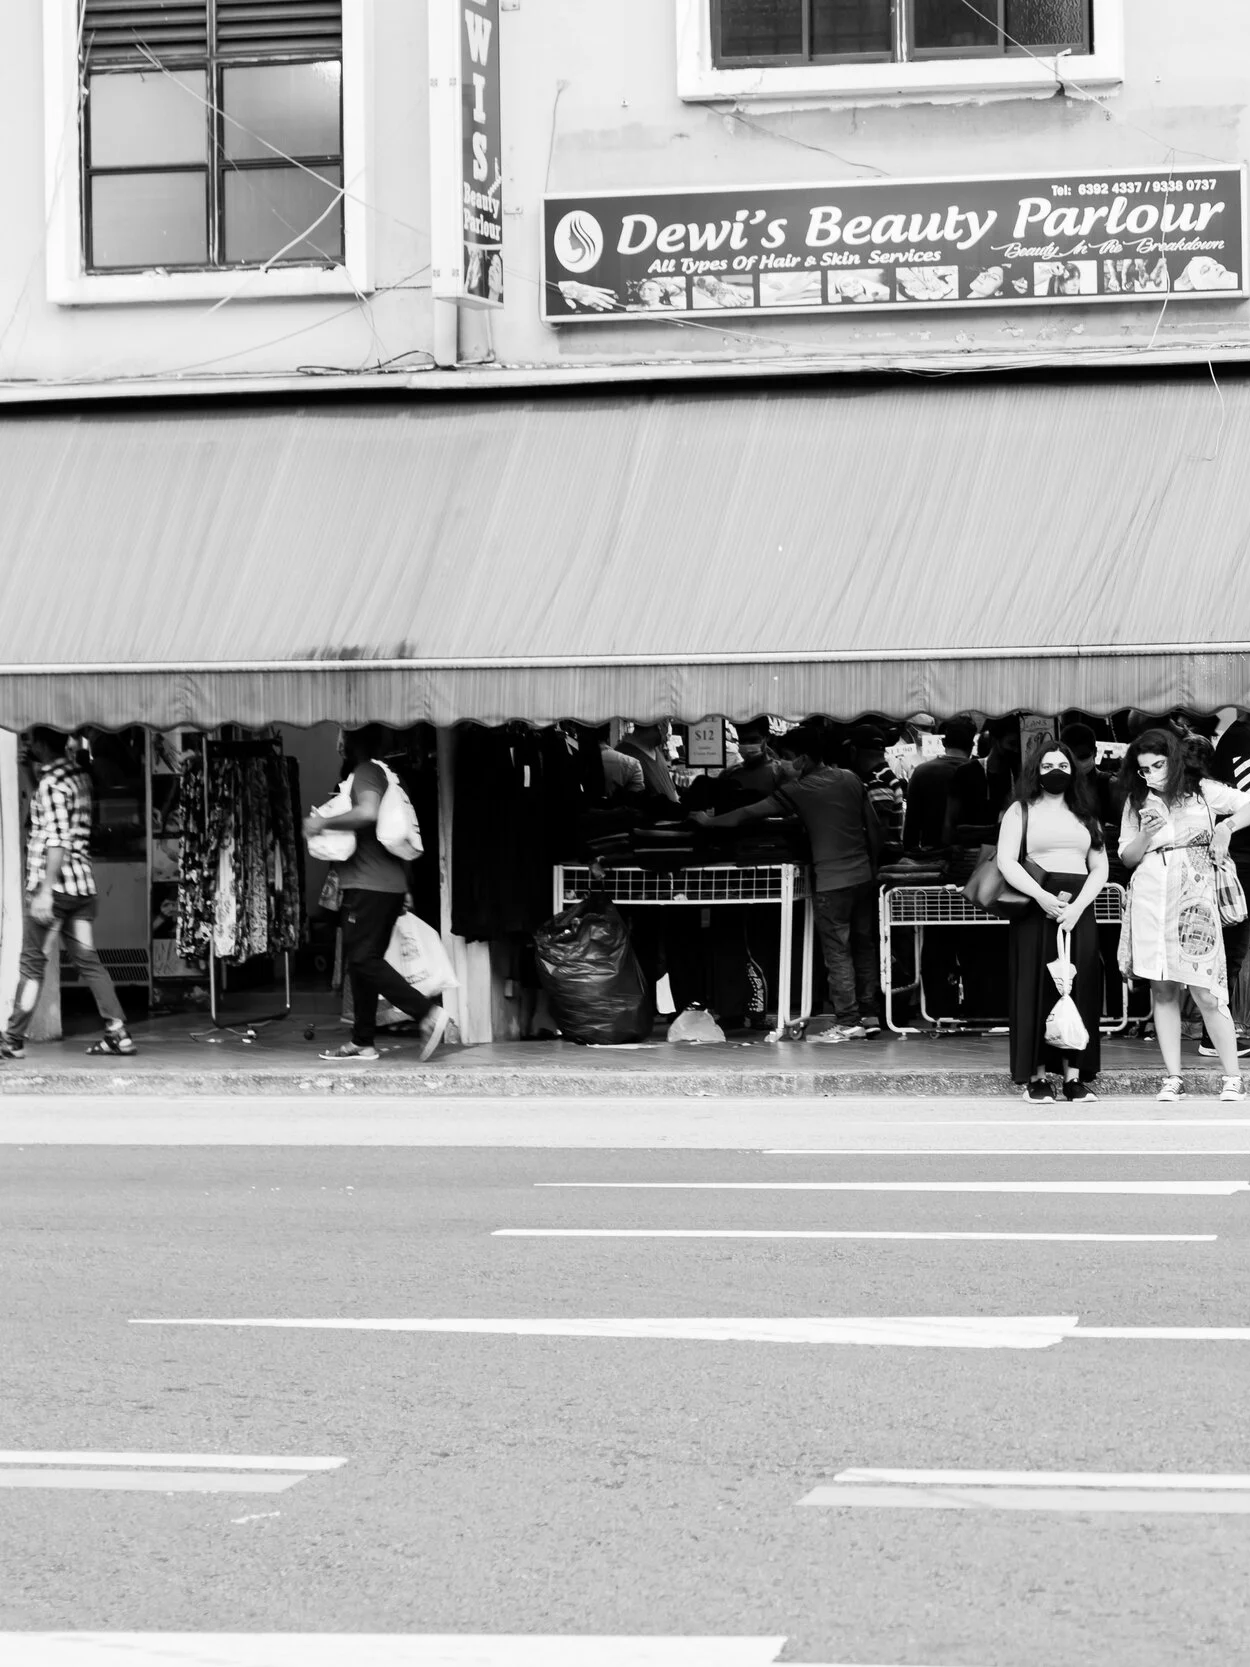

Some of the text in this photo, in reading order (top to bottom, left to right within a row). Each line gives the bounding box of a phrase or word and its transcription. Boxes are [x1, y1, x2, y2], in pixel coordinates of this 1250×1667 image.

[464, 0, 492, 182] WIS
[464, 181, 500, 219] Beauty
[1051, 185, 1072, 196] Tel:
[1078, 183, 1109, 195] 6392
[1112, 182, 1142, 193] 4337
[1144, 181, 1150, 193] /
[1186, 179, 1217, 191] 0737
[464, 207, 501, 241] Parlour
[616, 196, 1225, 255] Dewi's Beauty Parlour
[648, 249, 941, 274] All Types Of Hair & Skin Services
[991, 242, 1059, 260] Beauty
[1089, 239, 1123, 254] The
[1123, 237, 1224, 254] Breakdown
